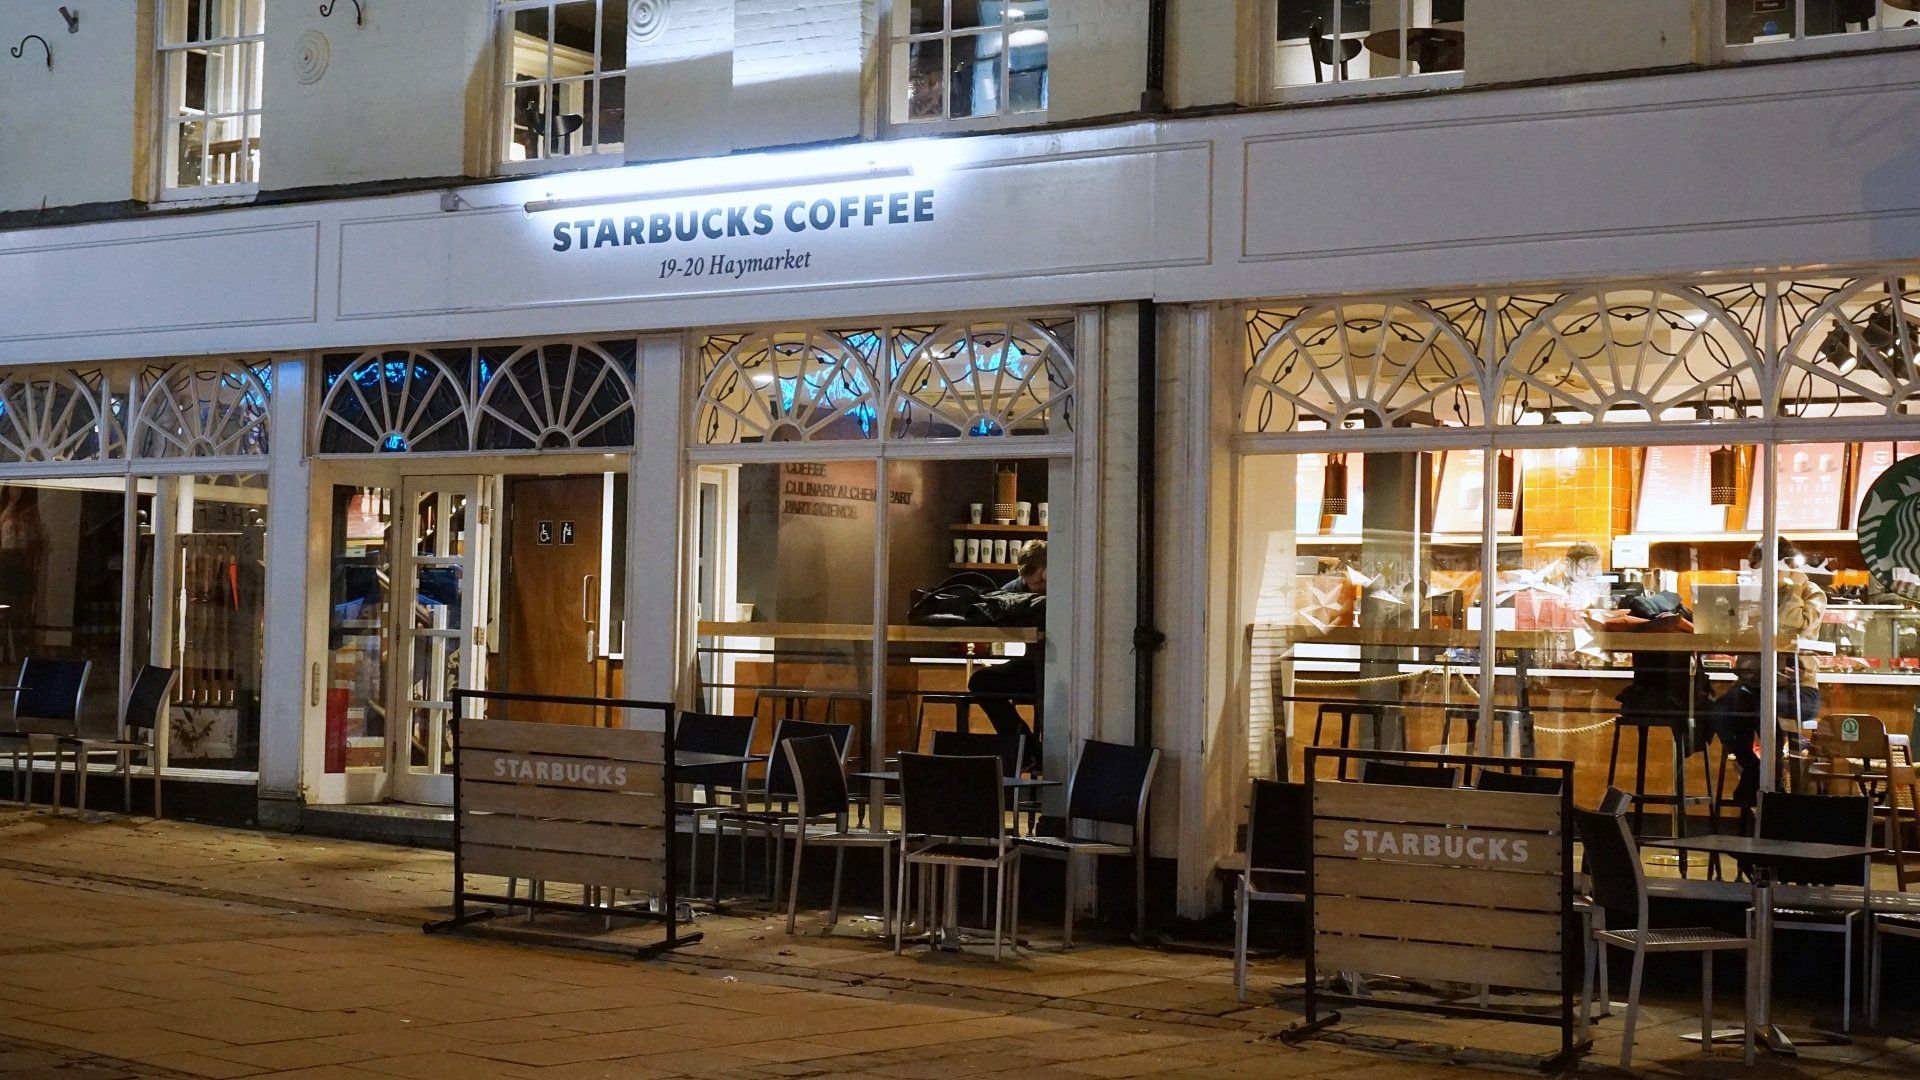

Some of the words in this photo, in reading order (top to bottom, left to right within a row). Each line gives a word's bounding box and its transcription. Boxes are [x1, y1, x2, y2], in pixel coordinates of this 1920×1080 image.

[552, 204, 773, 251] STARBUCKS
[784, 189, 935, 232] COFFEE
[658, 257, 705, 280] 19-20
[709, 249, 812, 280] Haymarket
[784, 462, 827, 476] COFFEE
[785, 480, 836, 498] CULINARY
[784, 499, 811, 515] PART
[811, 502, 858, 520] SCIENCE
[494, 758, 627, 786] STARBUCKS
[1343, 828, 1529, 863] STARBUCKS
